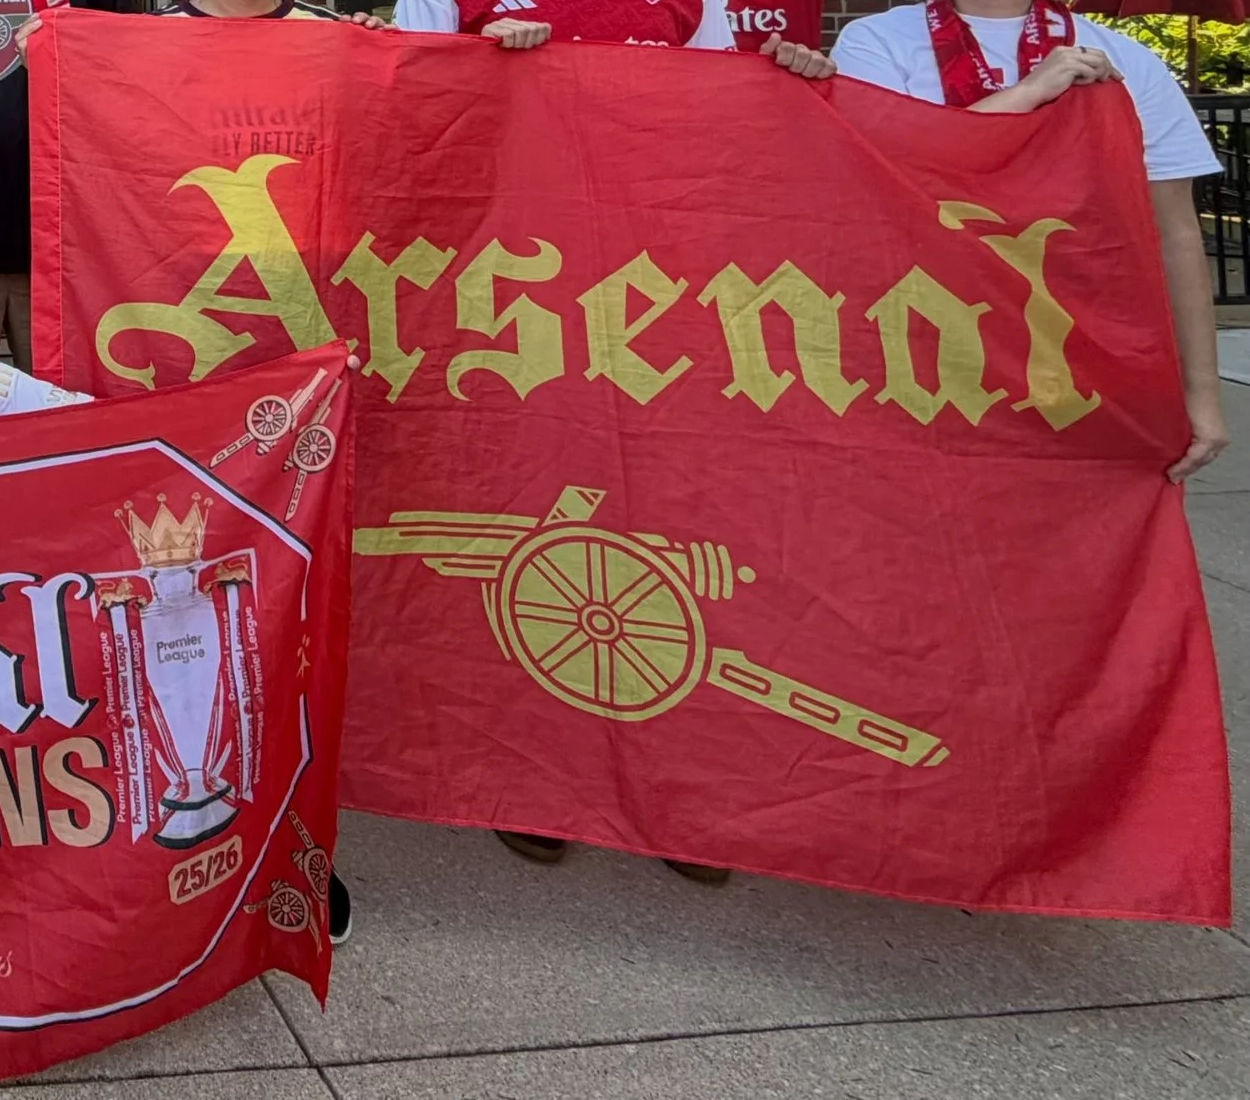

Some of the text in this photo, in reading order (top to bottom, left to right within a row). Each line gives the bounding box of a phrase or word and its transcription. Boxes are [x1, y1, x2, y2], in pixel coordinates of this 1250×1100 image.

[95, 153, 1101, 431] Arsenal
[156, 634, 203, 651] Premier
[245, 606, 258, 651] League
[157, 648, 206, 664] League
[252, 653, 264, 696] Premier
[100, 632, 127, 823] Premier League Premier League
[126, 731, 138, 776] League
[132, 779, 142, 825] Premier
[174, 843, 238, 899] 25/26
